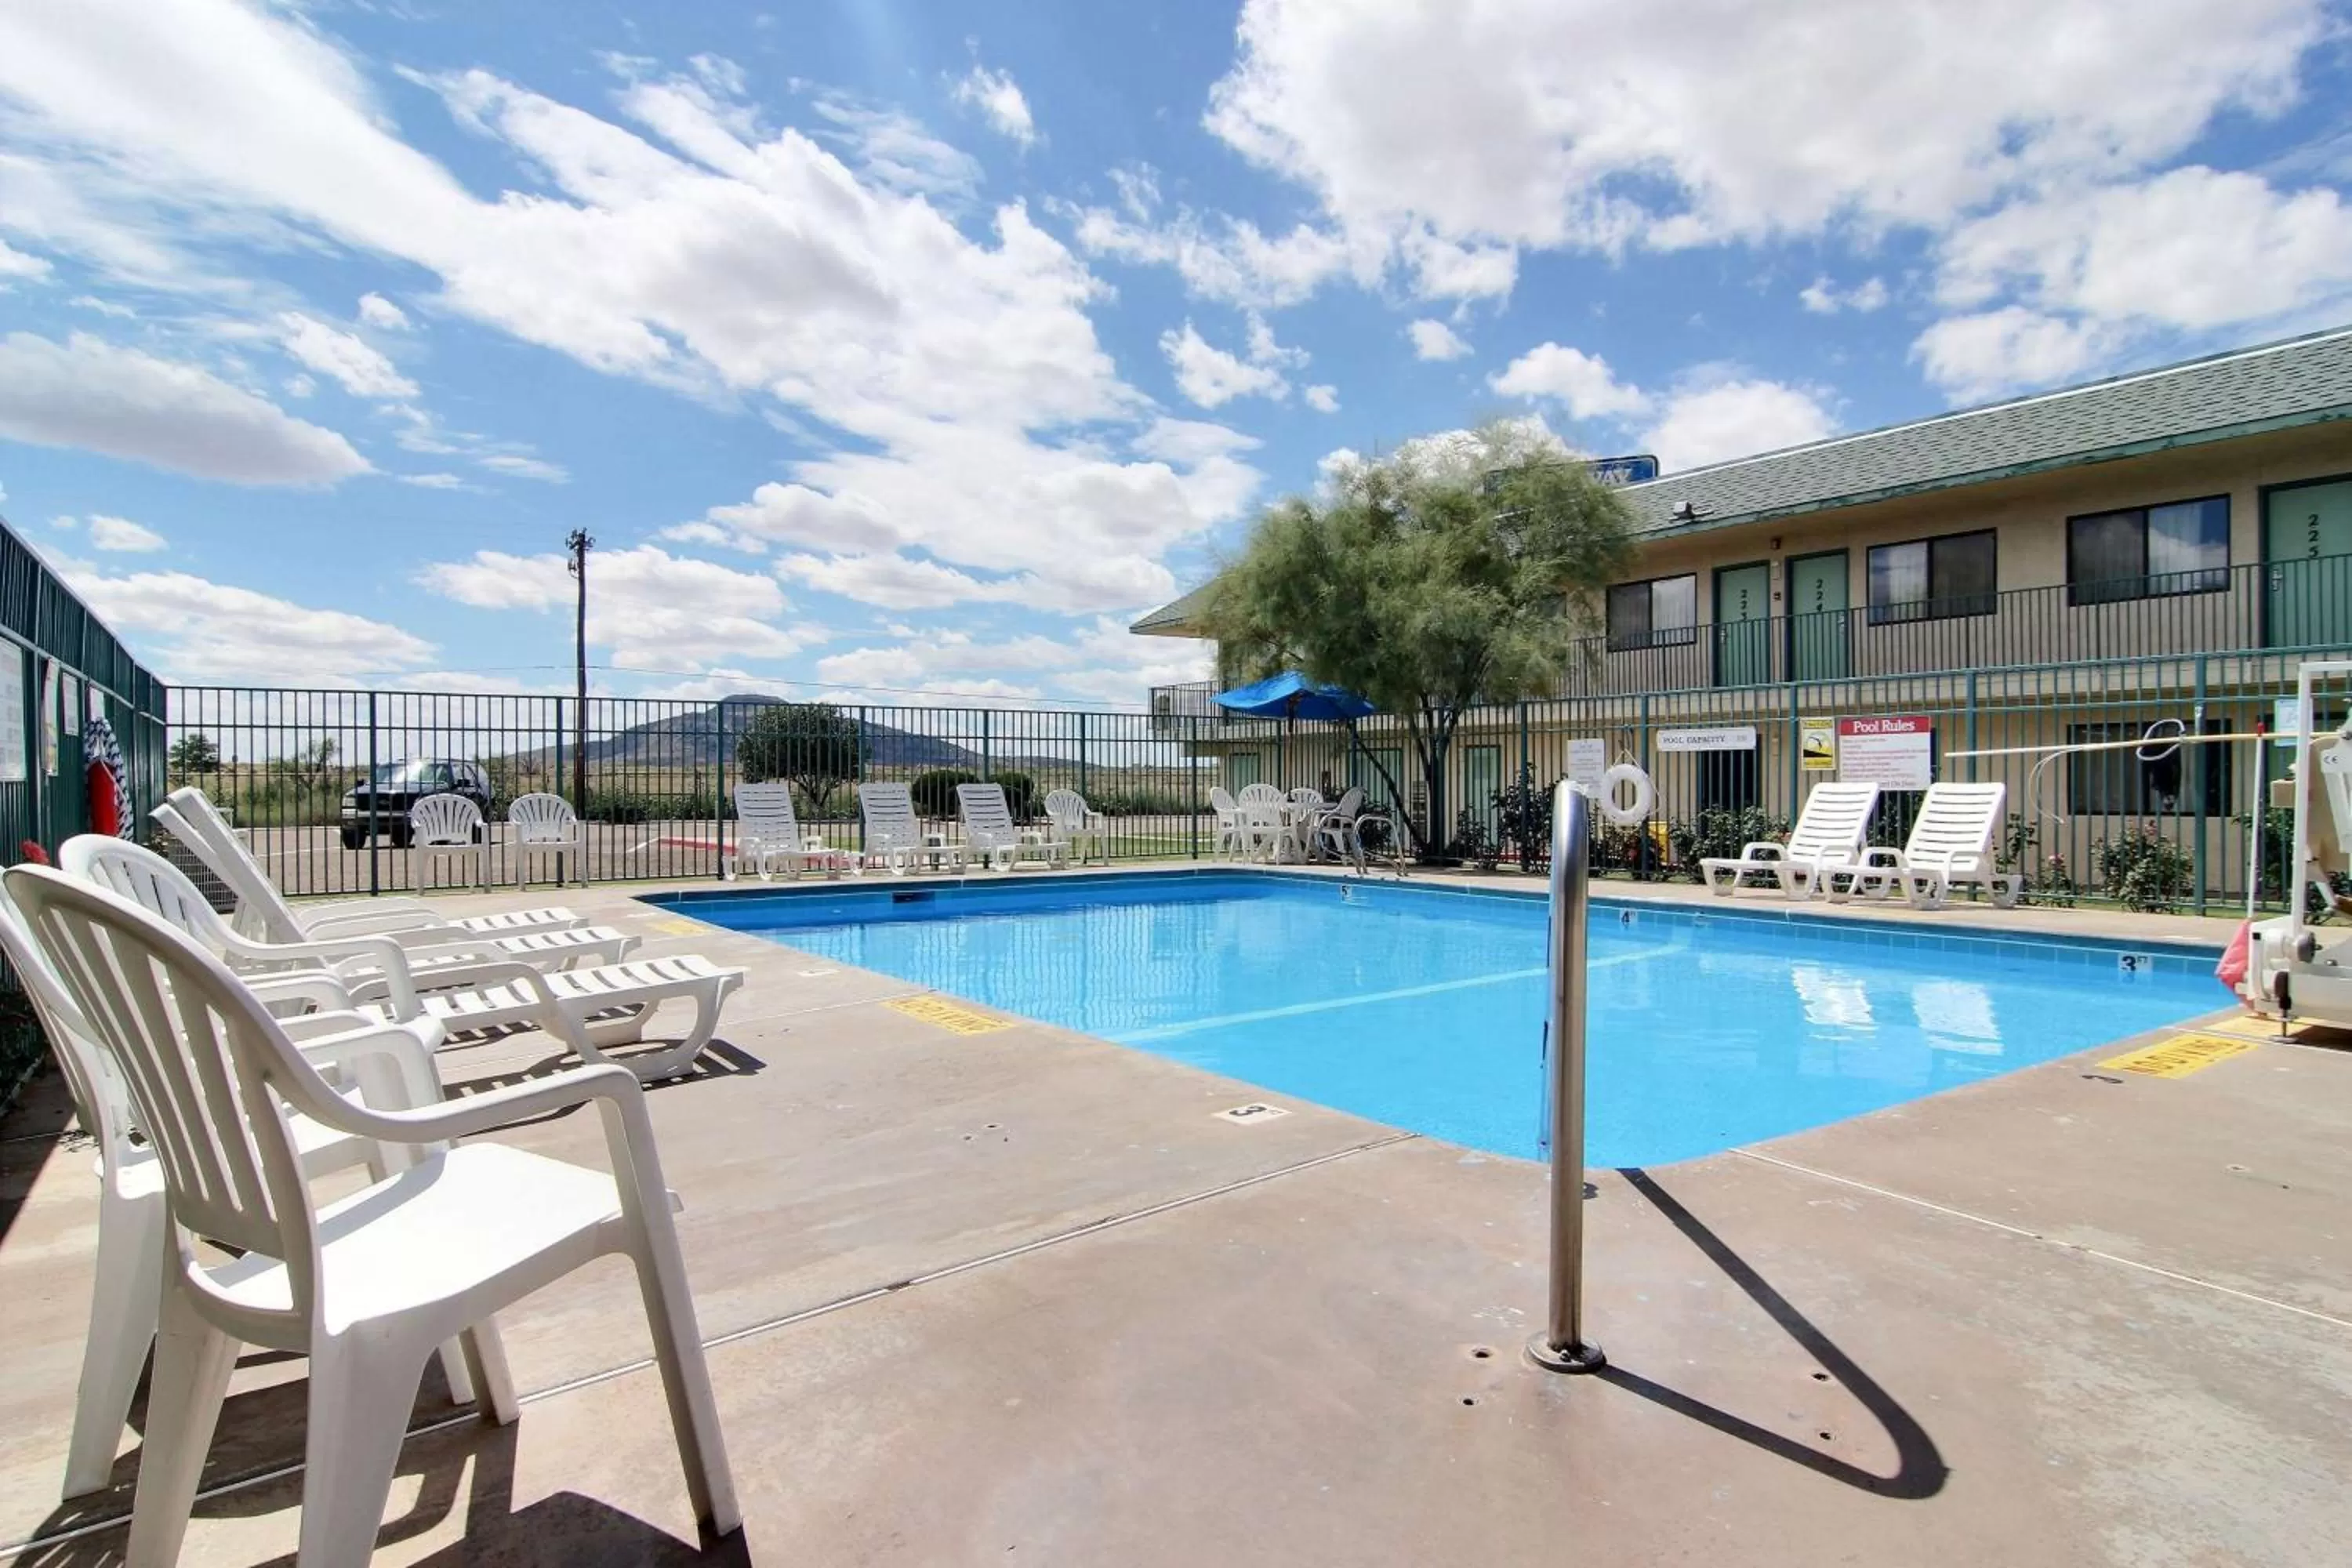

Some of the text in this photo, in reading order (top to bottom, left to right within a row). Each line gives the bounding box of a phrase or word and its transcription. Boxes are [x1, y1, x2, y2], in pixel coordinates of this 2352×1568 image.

[2307, 514, 2319, 560] 225
[1853, 719, 1915, 733] Pool Rules
[1686, 735, 1726, 744] CAPACITY
[2122, 956, 2136, 971] 3
